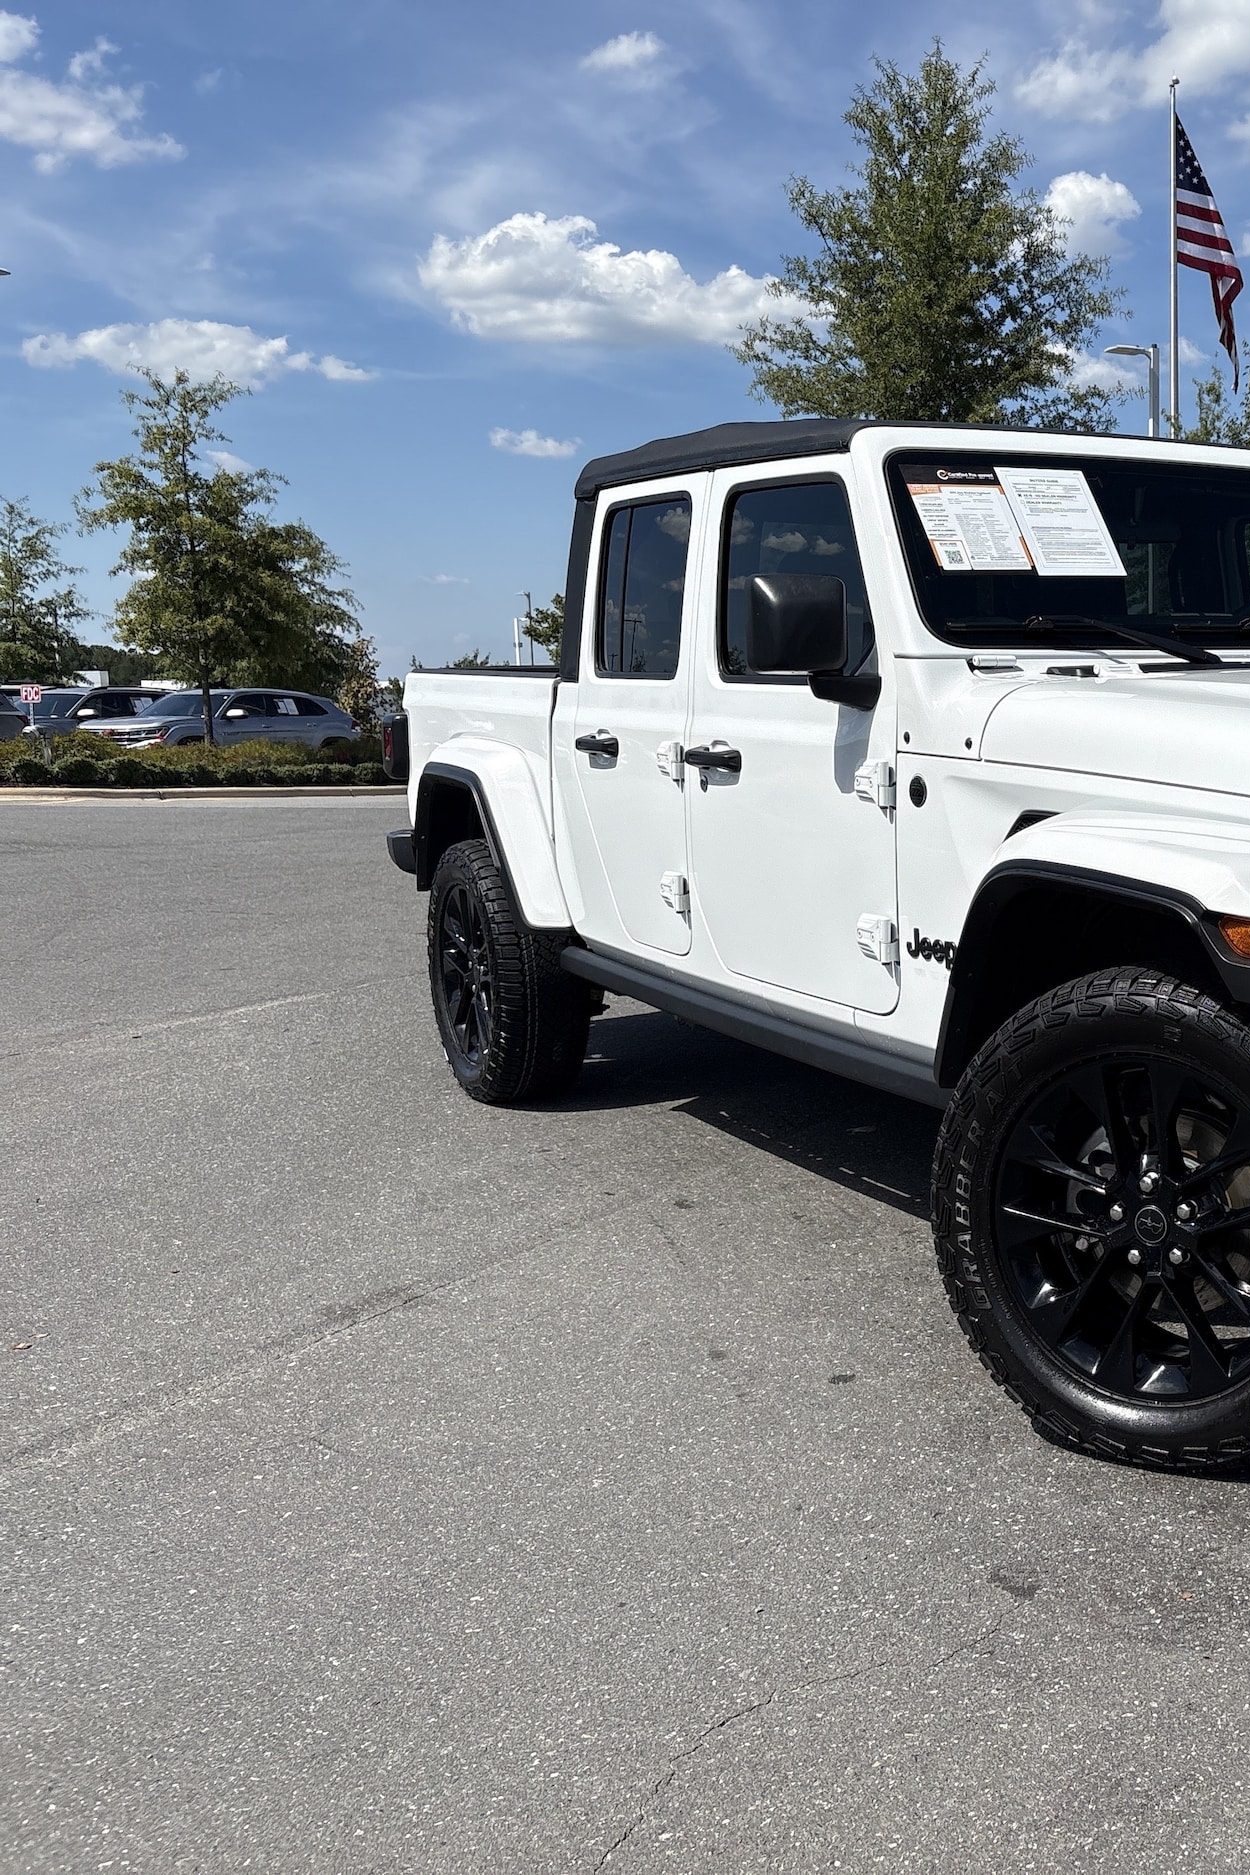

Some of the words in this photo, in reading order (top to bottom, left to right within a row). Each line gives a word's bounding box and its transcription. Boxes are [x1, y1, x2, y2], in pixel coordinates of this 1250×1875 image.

[22, 687, 39, 700] FDC
[906, 927, 957, 971] Jeep
[954, 1119, 994, 1310] GRABBER
